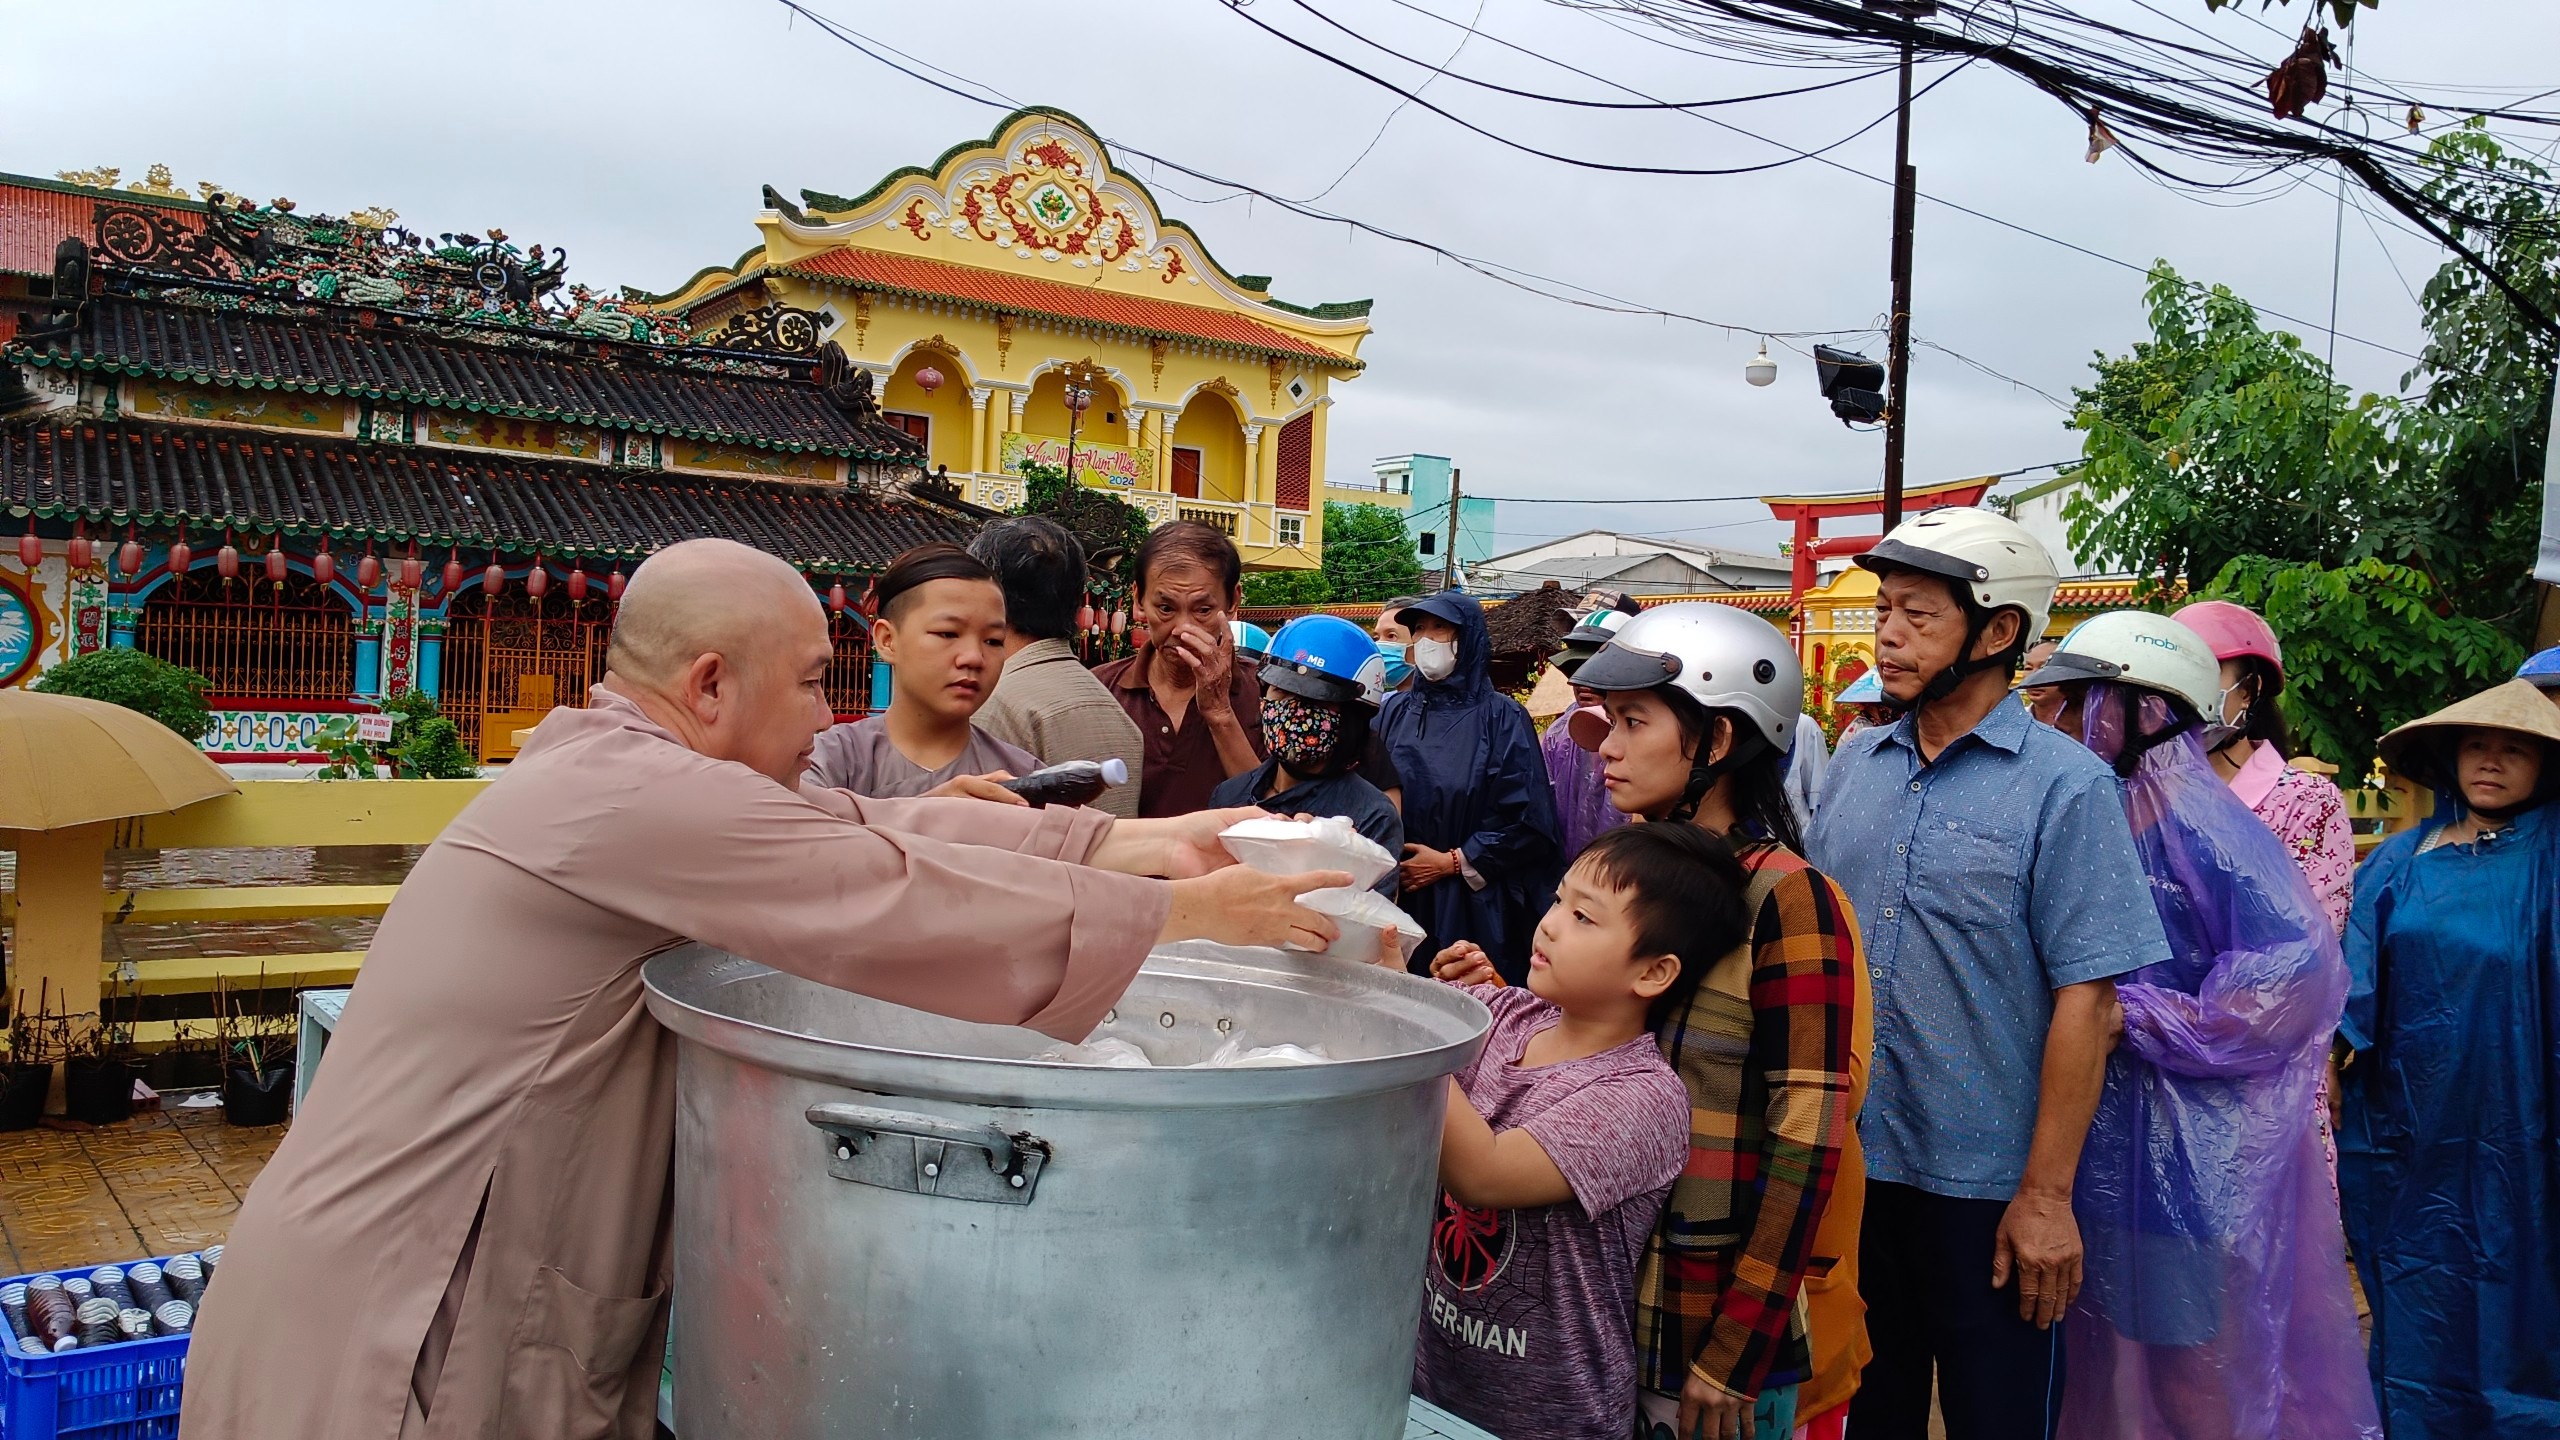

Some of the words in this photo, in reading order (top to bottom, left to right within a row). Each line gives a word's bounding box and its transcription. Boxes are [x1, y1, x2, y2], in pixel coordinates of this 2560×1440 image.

[1025, 440, 1054, 463] Chúc
[1056, 446, 1084, 476] Mng
[1109, 475, 1135, 487] 2024
[1306, 654, 1326, 668] MB
[362, 717, 373, 726] XIN
[373, 730, 386, 739] HOA
